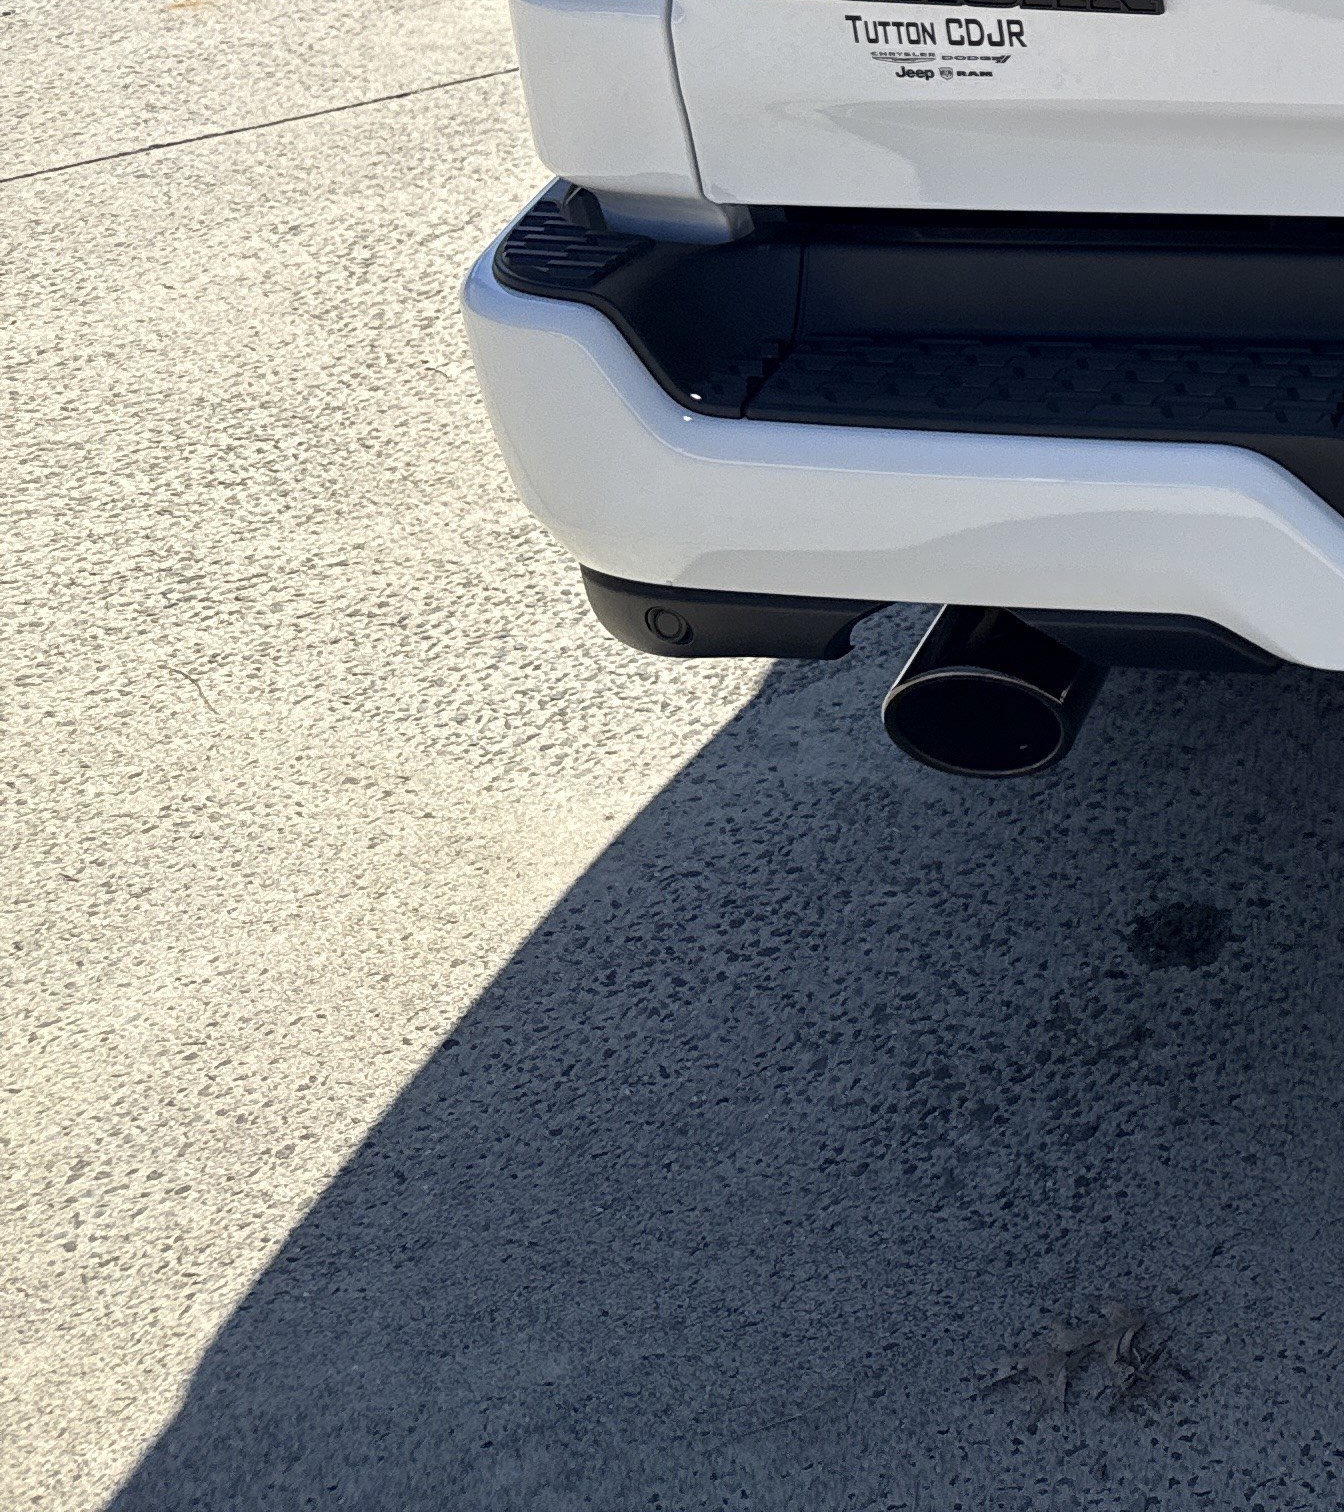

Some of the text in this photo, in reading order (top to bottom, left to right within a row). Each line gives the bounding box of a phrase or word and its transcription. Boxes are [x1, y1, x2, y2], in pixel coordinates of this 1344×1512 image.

[845, 15, 1027, 47] TUTTON CDJR
[895, 66, 935, 80] Jeep
